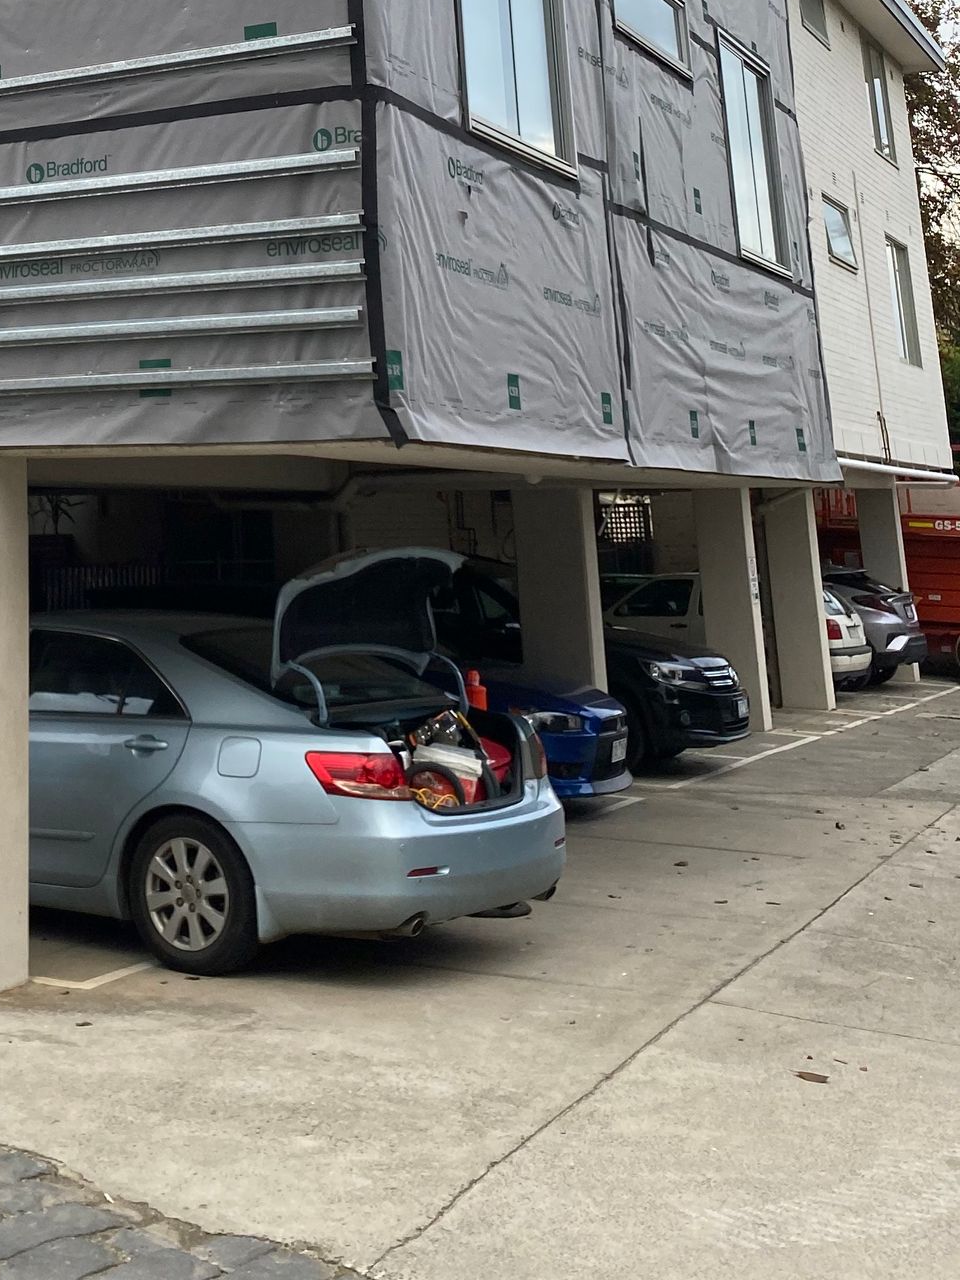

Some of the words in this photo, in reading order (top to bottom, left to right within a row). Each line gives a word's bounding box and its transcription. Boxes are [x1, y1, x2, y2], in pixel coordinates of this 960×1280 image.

[47, 157, 108, 178] Bradford
[267, 231, 360, 257] enviroseal
[70, 256, 155, 275] PROCTORWRAP
